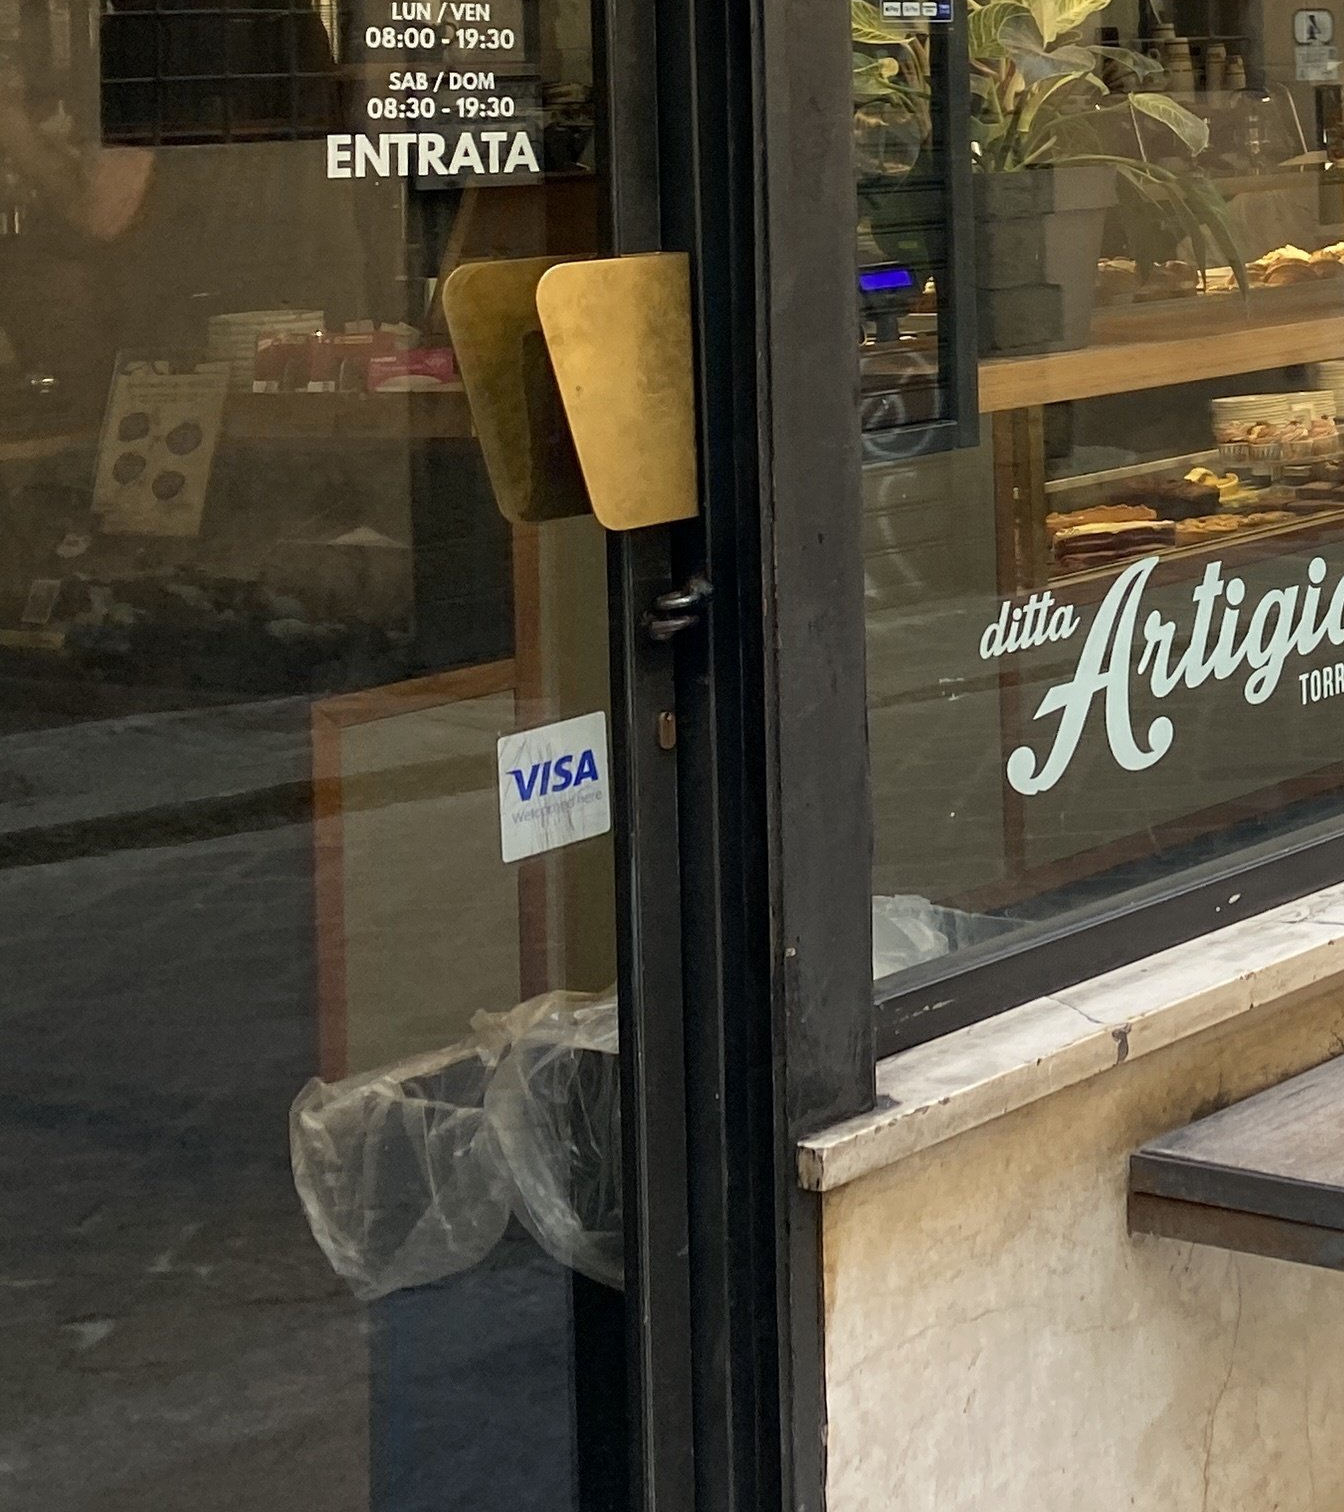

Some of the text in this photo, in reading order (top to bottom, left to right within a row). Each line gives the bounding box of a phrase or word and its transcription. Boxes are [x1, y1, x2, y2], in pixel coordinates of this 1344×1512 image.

[391, 2, 431, 21] LUN
[450, 3, 490, 21] VEN
[365, 27, 435, 49] 08:00
[456, 28, 515, 49] 19:30
[389, 72, 428, 90] SAB
[449, 72, 495, 90] DOM
[367, 97, 435, 118] 08:30
[456, 97, 515, 118] 19:30
[326, 131, 540, 179] ENTRATA
[979, 590, 1080, 660] ditta
[506, 749, 598, 801] VISA
[576, 789, 602, 806] here
